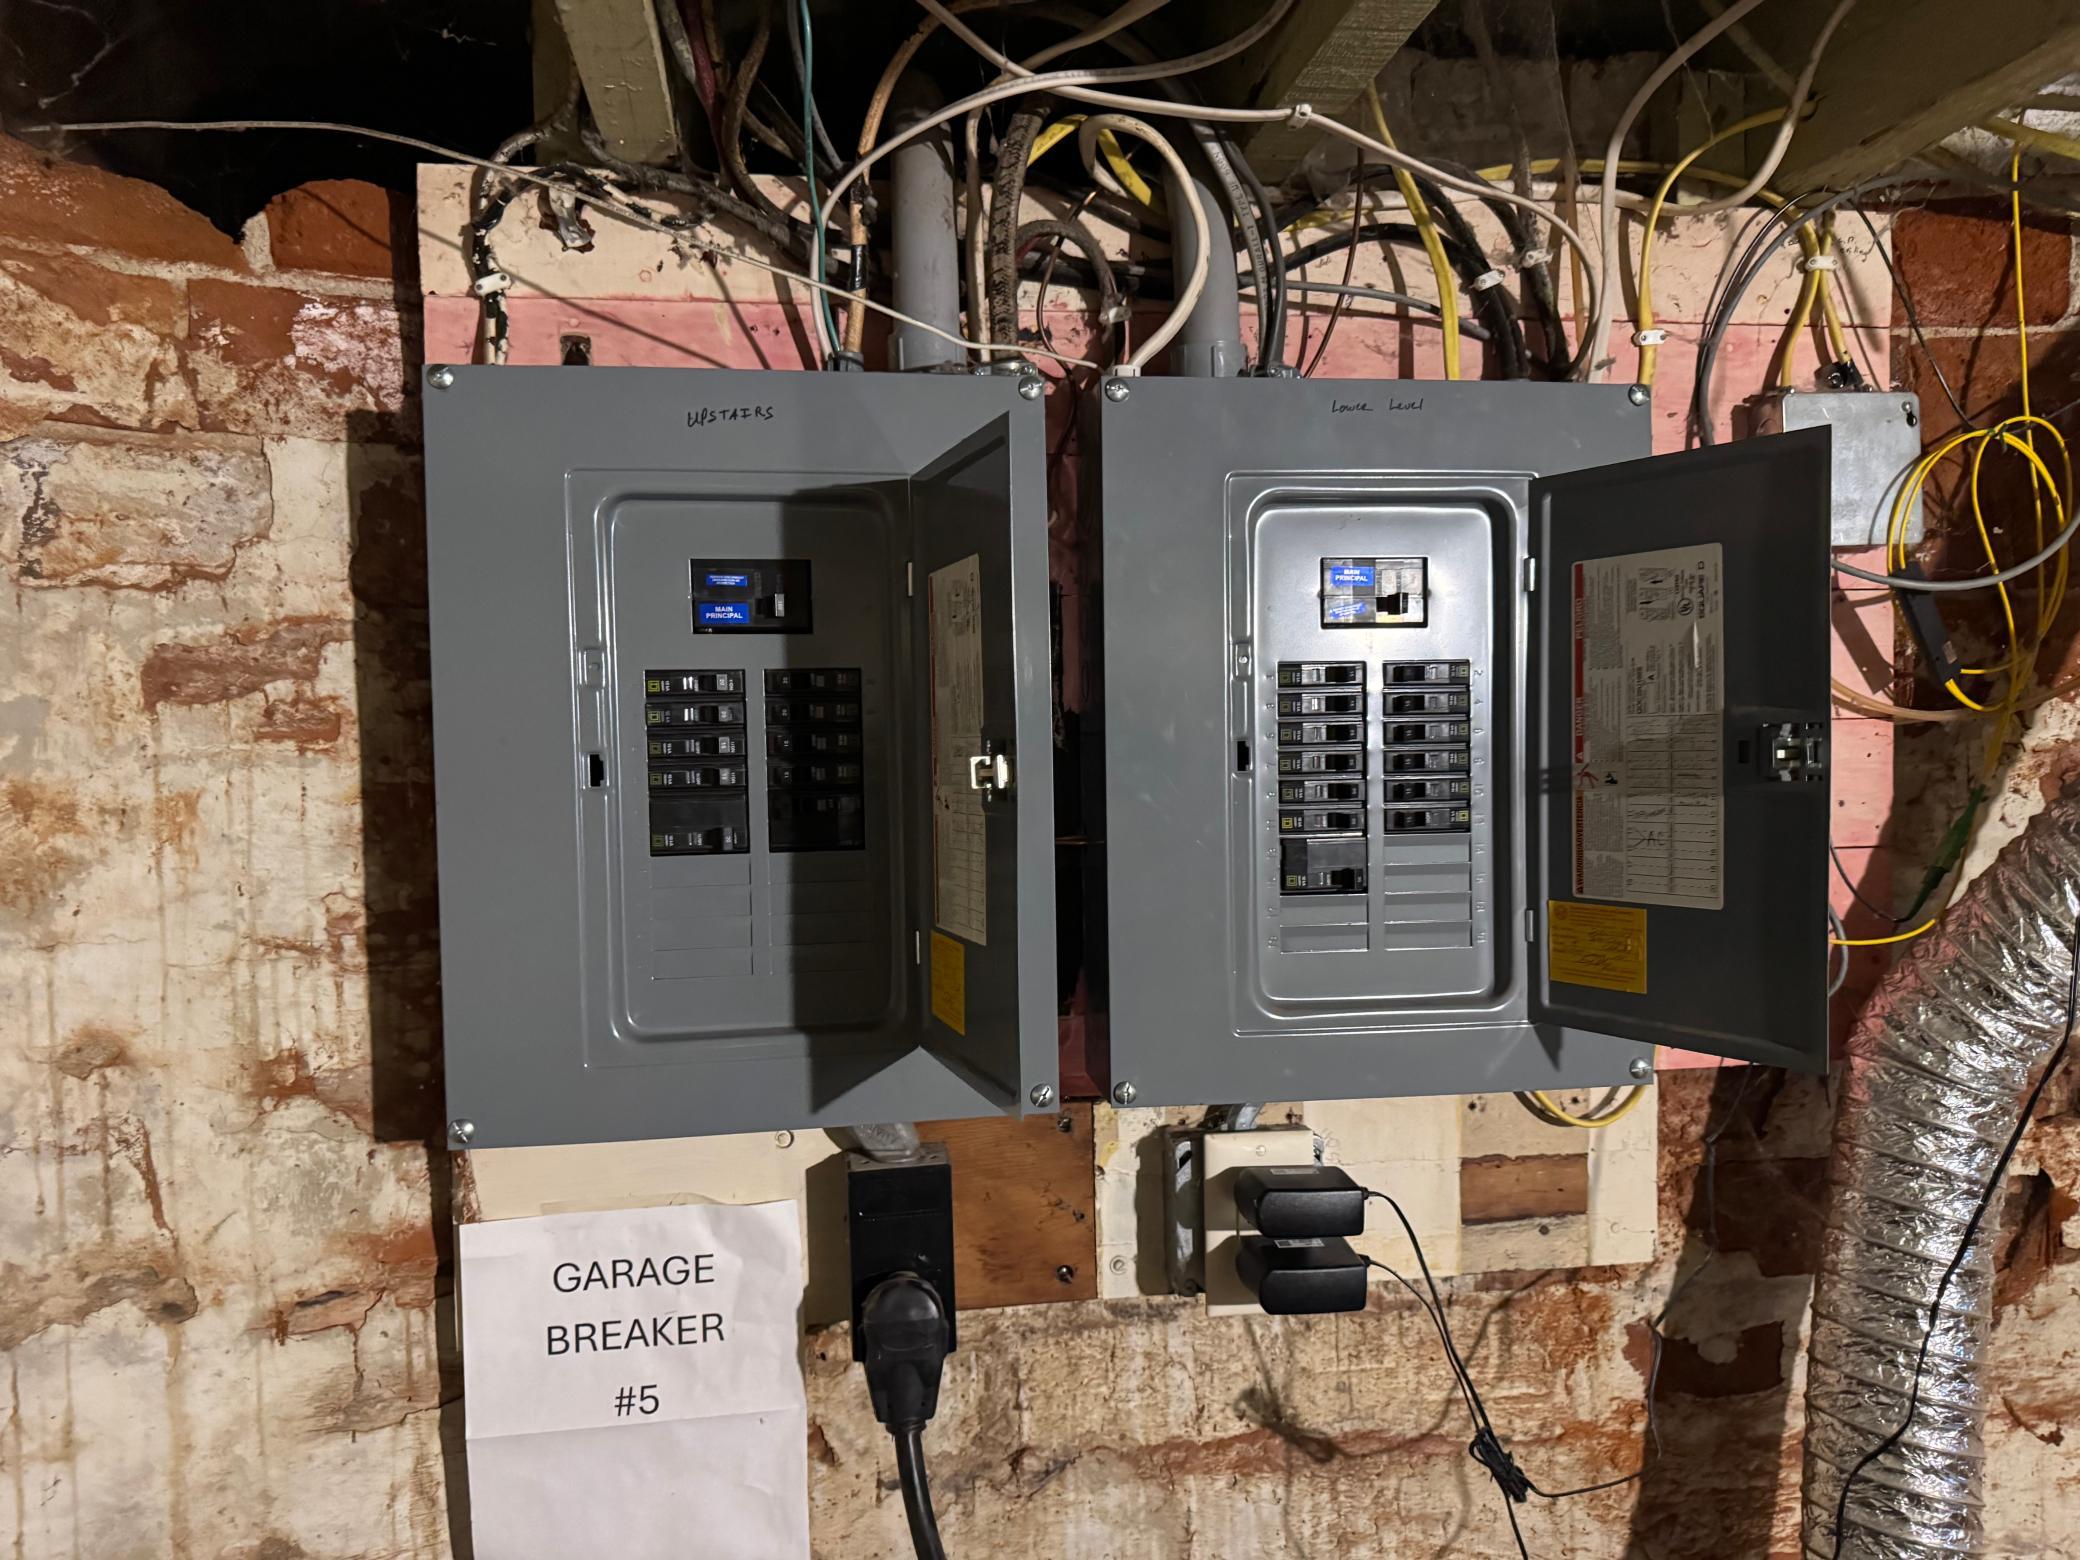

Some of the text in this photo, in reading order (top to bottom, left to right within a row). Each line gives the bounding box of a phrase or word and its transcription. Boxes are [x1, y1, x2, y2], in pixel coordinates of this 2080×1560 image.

[687, 406, 774, 427] UPSTAIRS
[1389, 398, 1424, 411] Level
[1697, 560, 1705, 619] SQUARE D
[1576, 796, 1584, 886] WARNING/ADVERTENCIA
[554, 1254, 714, 1292] GARAGE
[548, 1314, 724, 1355] BREAKER
[615, 1385, 658, 1416] #5
